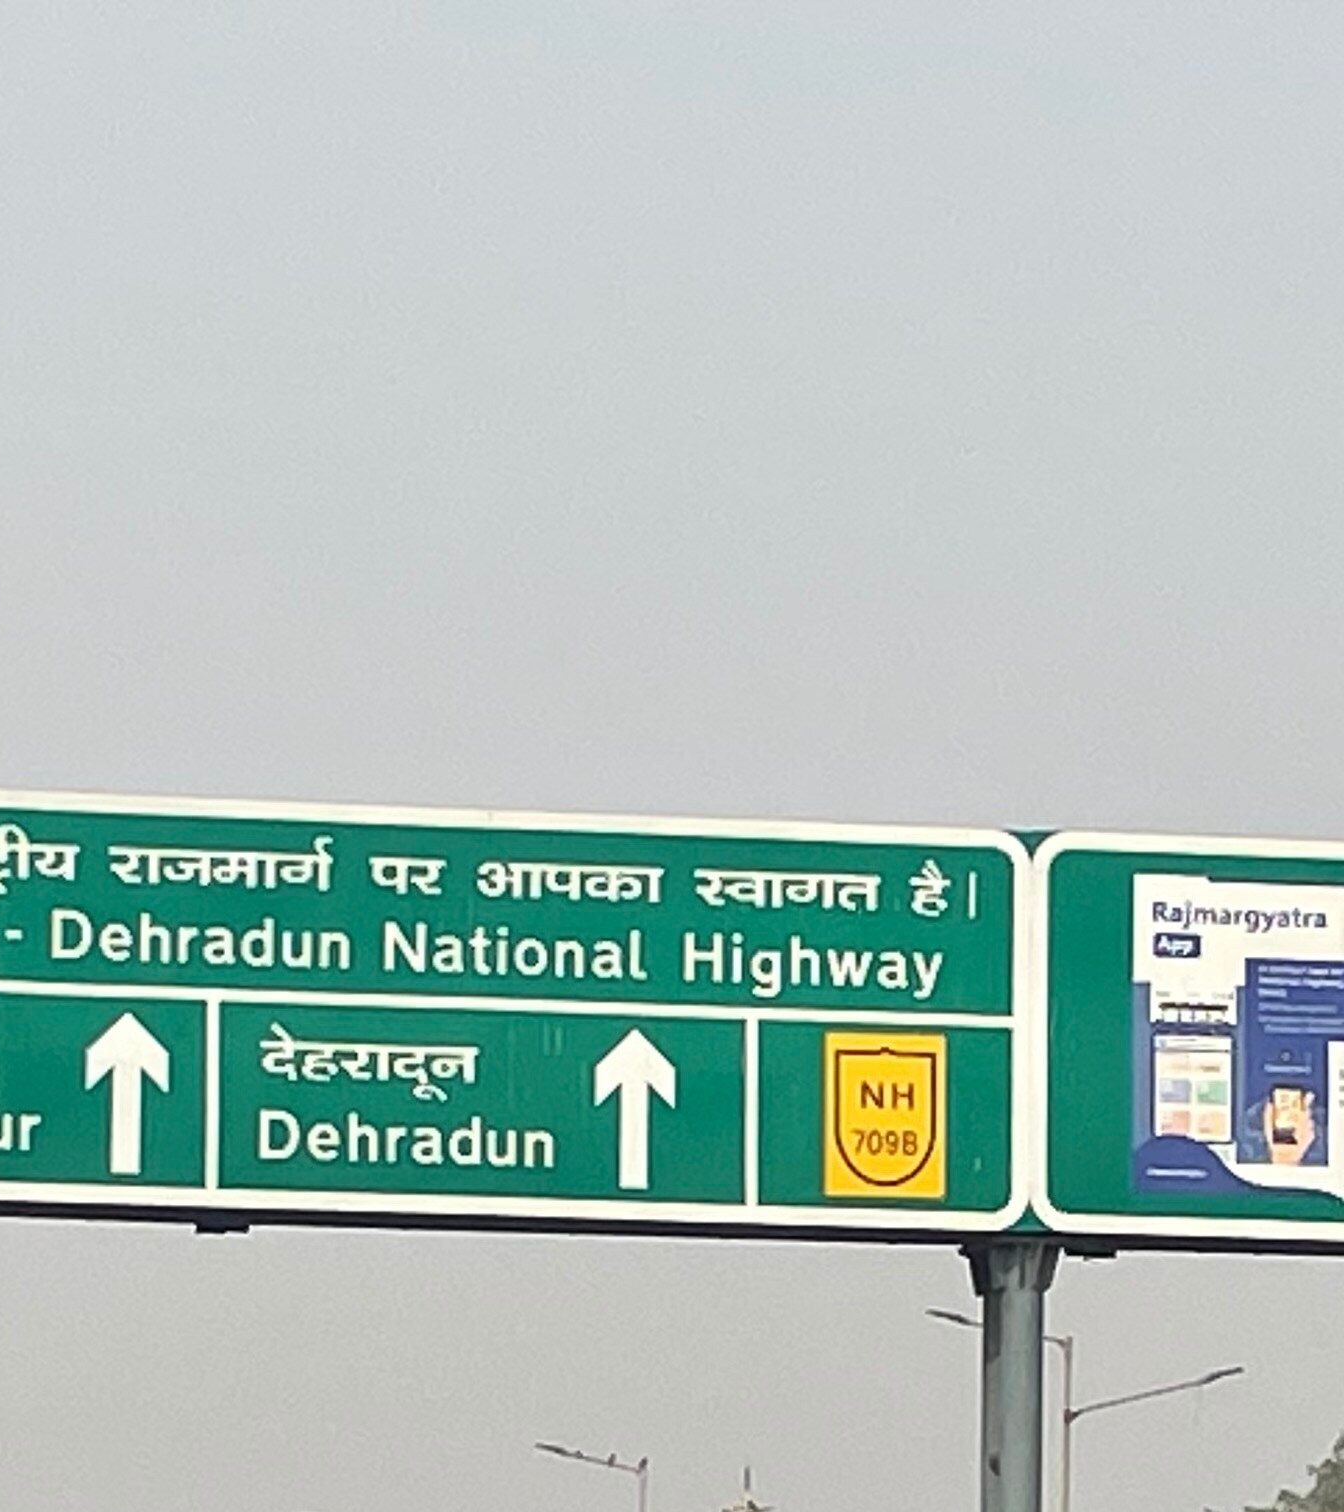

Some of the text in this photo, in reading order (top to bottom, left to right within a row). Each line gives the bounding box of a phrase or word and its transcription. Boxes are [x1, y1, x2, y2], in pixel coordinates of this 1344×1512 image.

[109, 837, 332, 892] राजमार्ग
[370, 854, 446, 898] पर
[476, 859, 664, 905] आपका
[694, 867, 880, 912] स्वागत
[1152, 901, 1328, 933] Rajmargyatra
[51, 910, 352, 971] Dehradun
[384, 921, 647, 981] National
[683, 932, 944, 998] Highway
[1158, 937, 1194, 956] App
[260, 1022, 479, 1101] देहरादून
[861, 1082, 916, 1113] NH
[258, 1110, 555, 1169] Dehradun
[852, 1130, 920, 1159] 709B
